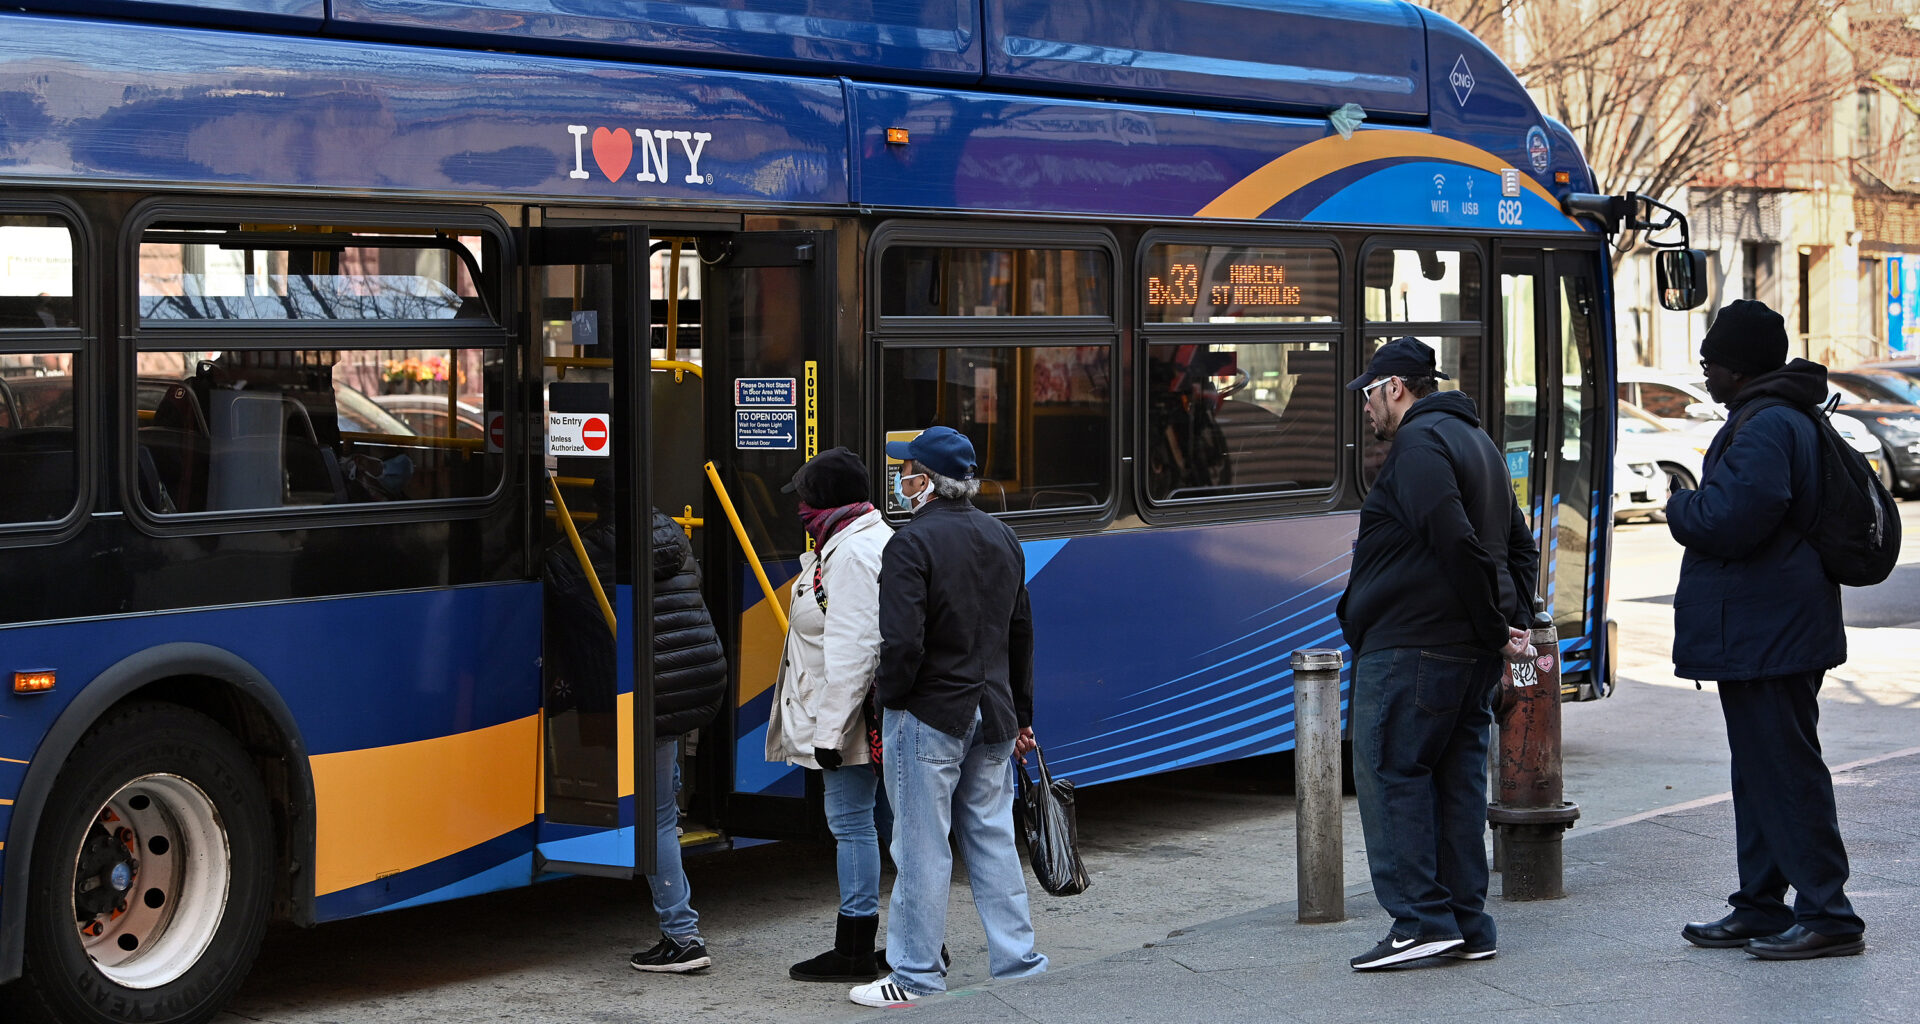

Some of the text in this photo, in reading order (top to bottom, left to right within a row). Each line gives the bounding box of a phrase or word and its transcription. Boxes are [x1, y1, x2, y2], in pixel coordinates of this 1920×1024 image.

[1452, 72, 1471, 88] CNG
[568, 124, 590, 180] I
[1431, 200, 1449, 213] WIFI
[1462, 202, 1479, 216] USB
[1498, 200, 1522, 225] 682
[1230, 265, 1284, 284] HARLEM
[1148, 264, 1198, 304] Bx33
[1212, 286, 1300, 304] ST NICHOLAS
[562, 417, 582, 427] Entry
